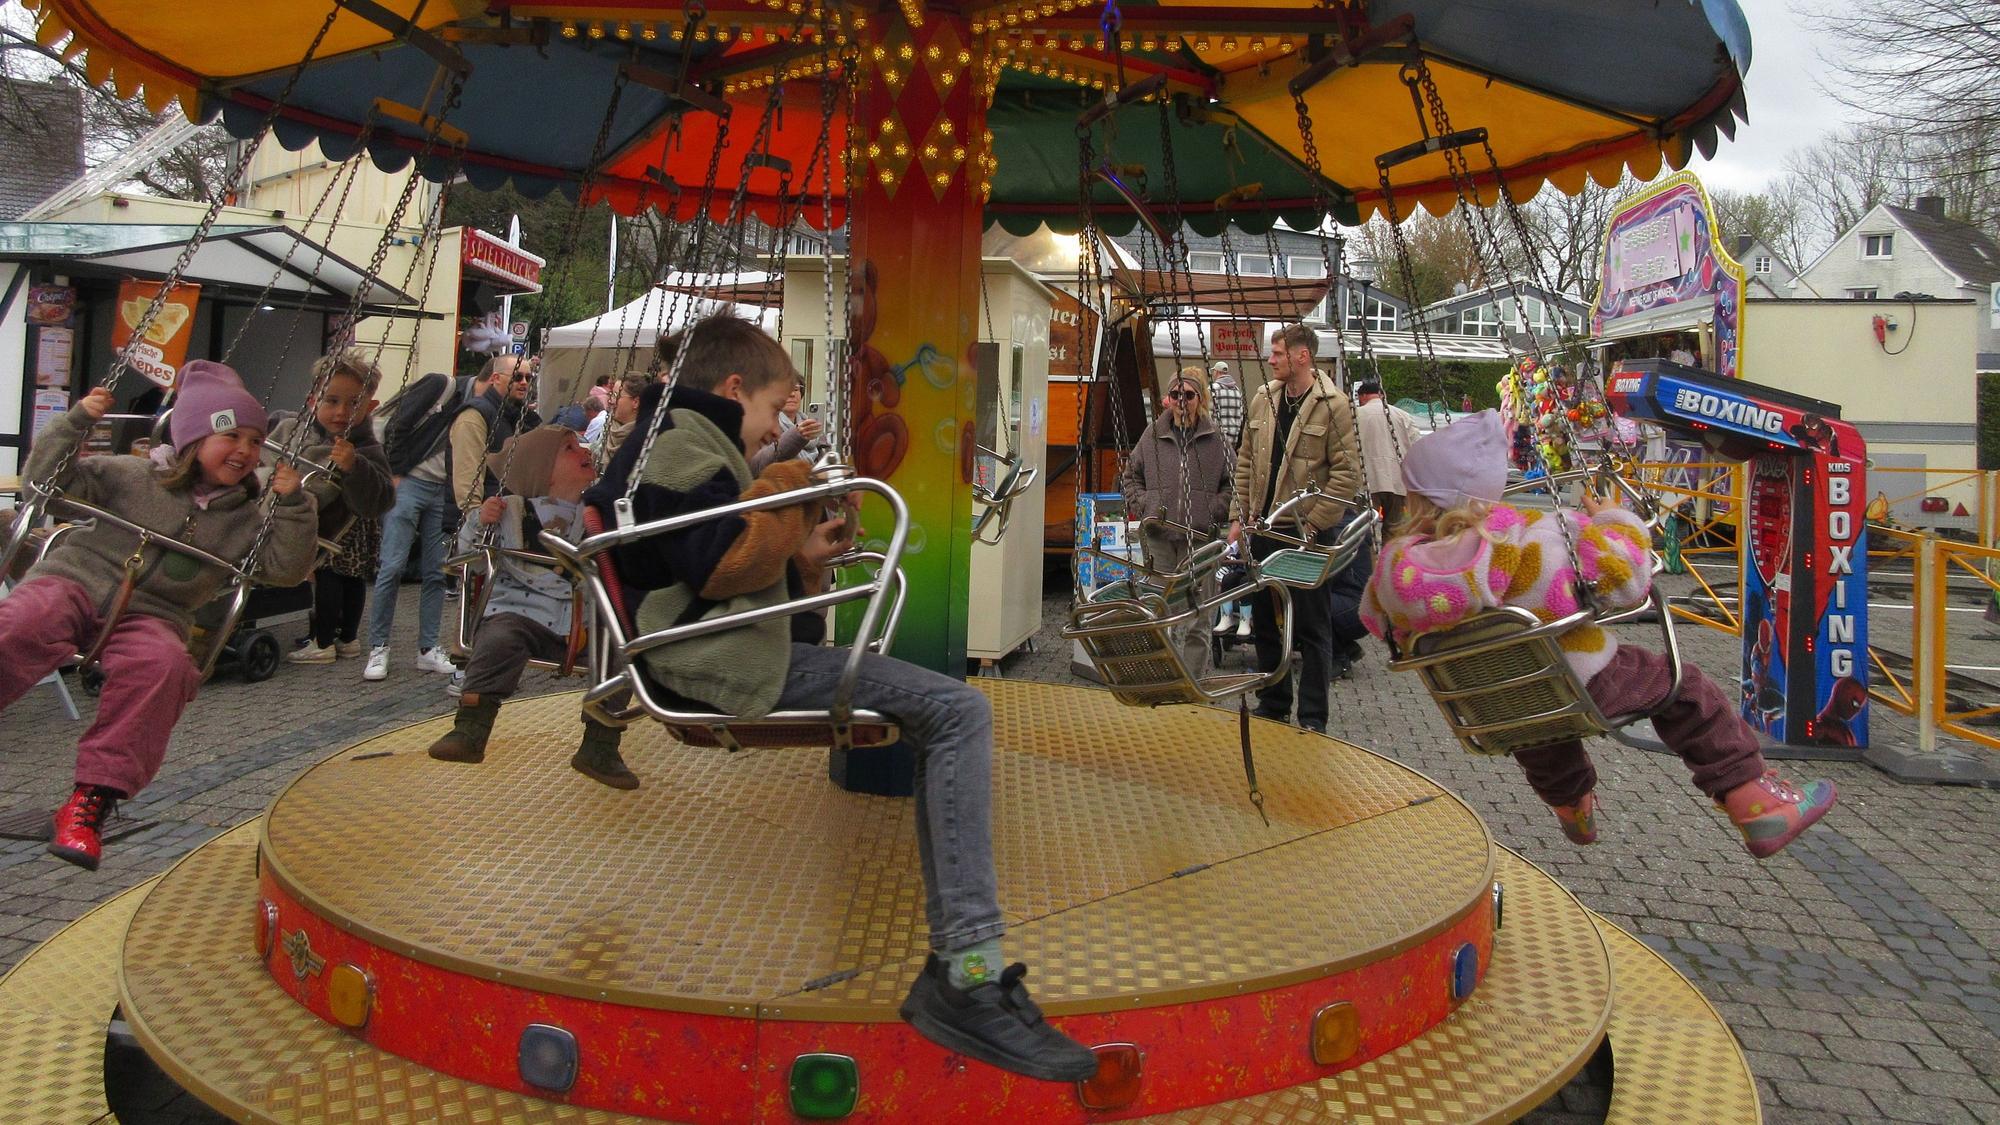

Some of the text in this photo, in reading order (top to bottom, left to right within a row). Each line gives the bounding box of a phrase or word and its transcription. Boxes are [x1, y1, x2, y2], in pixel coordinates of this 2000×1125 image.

[470, 239, 532, 279] SPIELTRUCK
[136, 345, 158, 358] rische
[1215, 342, 1258, 352] Pomme
[132, 357, 173, 381] êpes
[1614, 378, 1641, 393] BOXING
[1674, 388, 1686, 409] KIDS
[1682, 389, 1783, 434] BOXING
[1828, 462, 1851, 473] KIDS
[1828, 477, 1854, 678] BOXING
